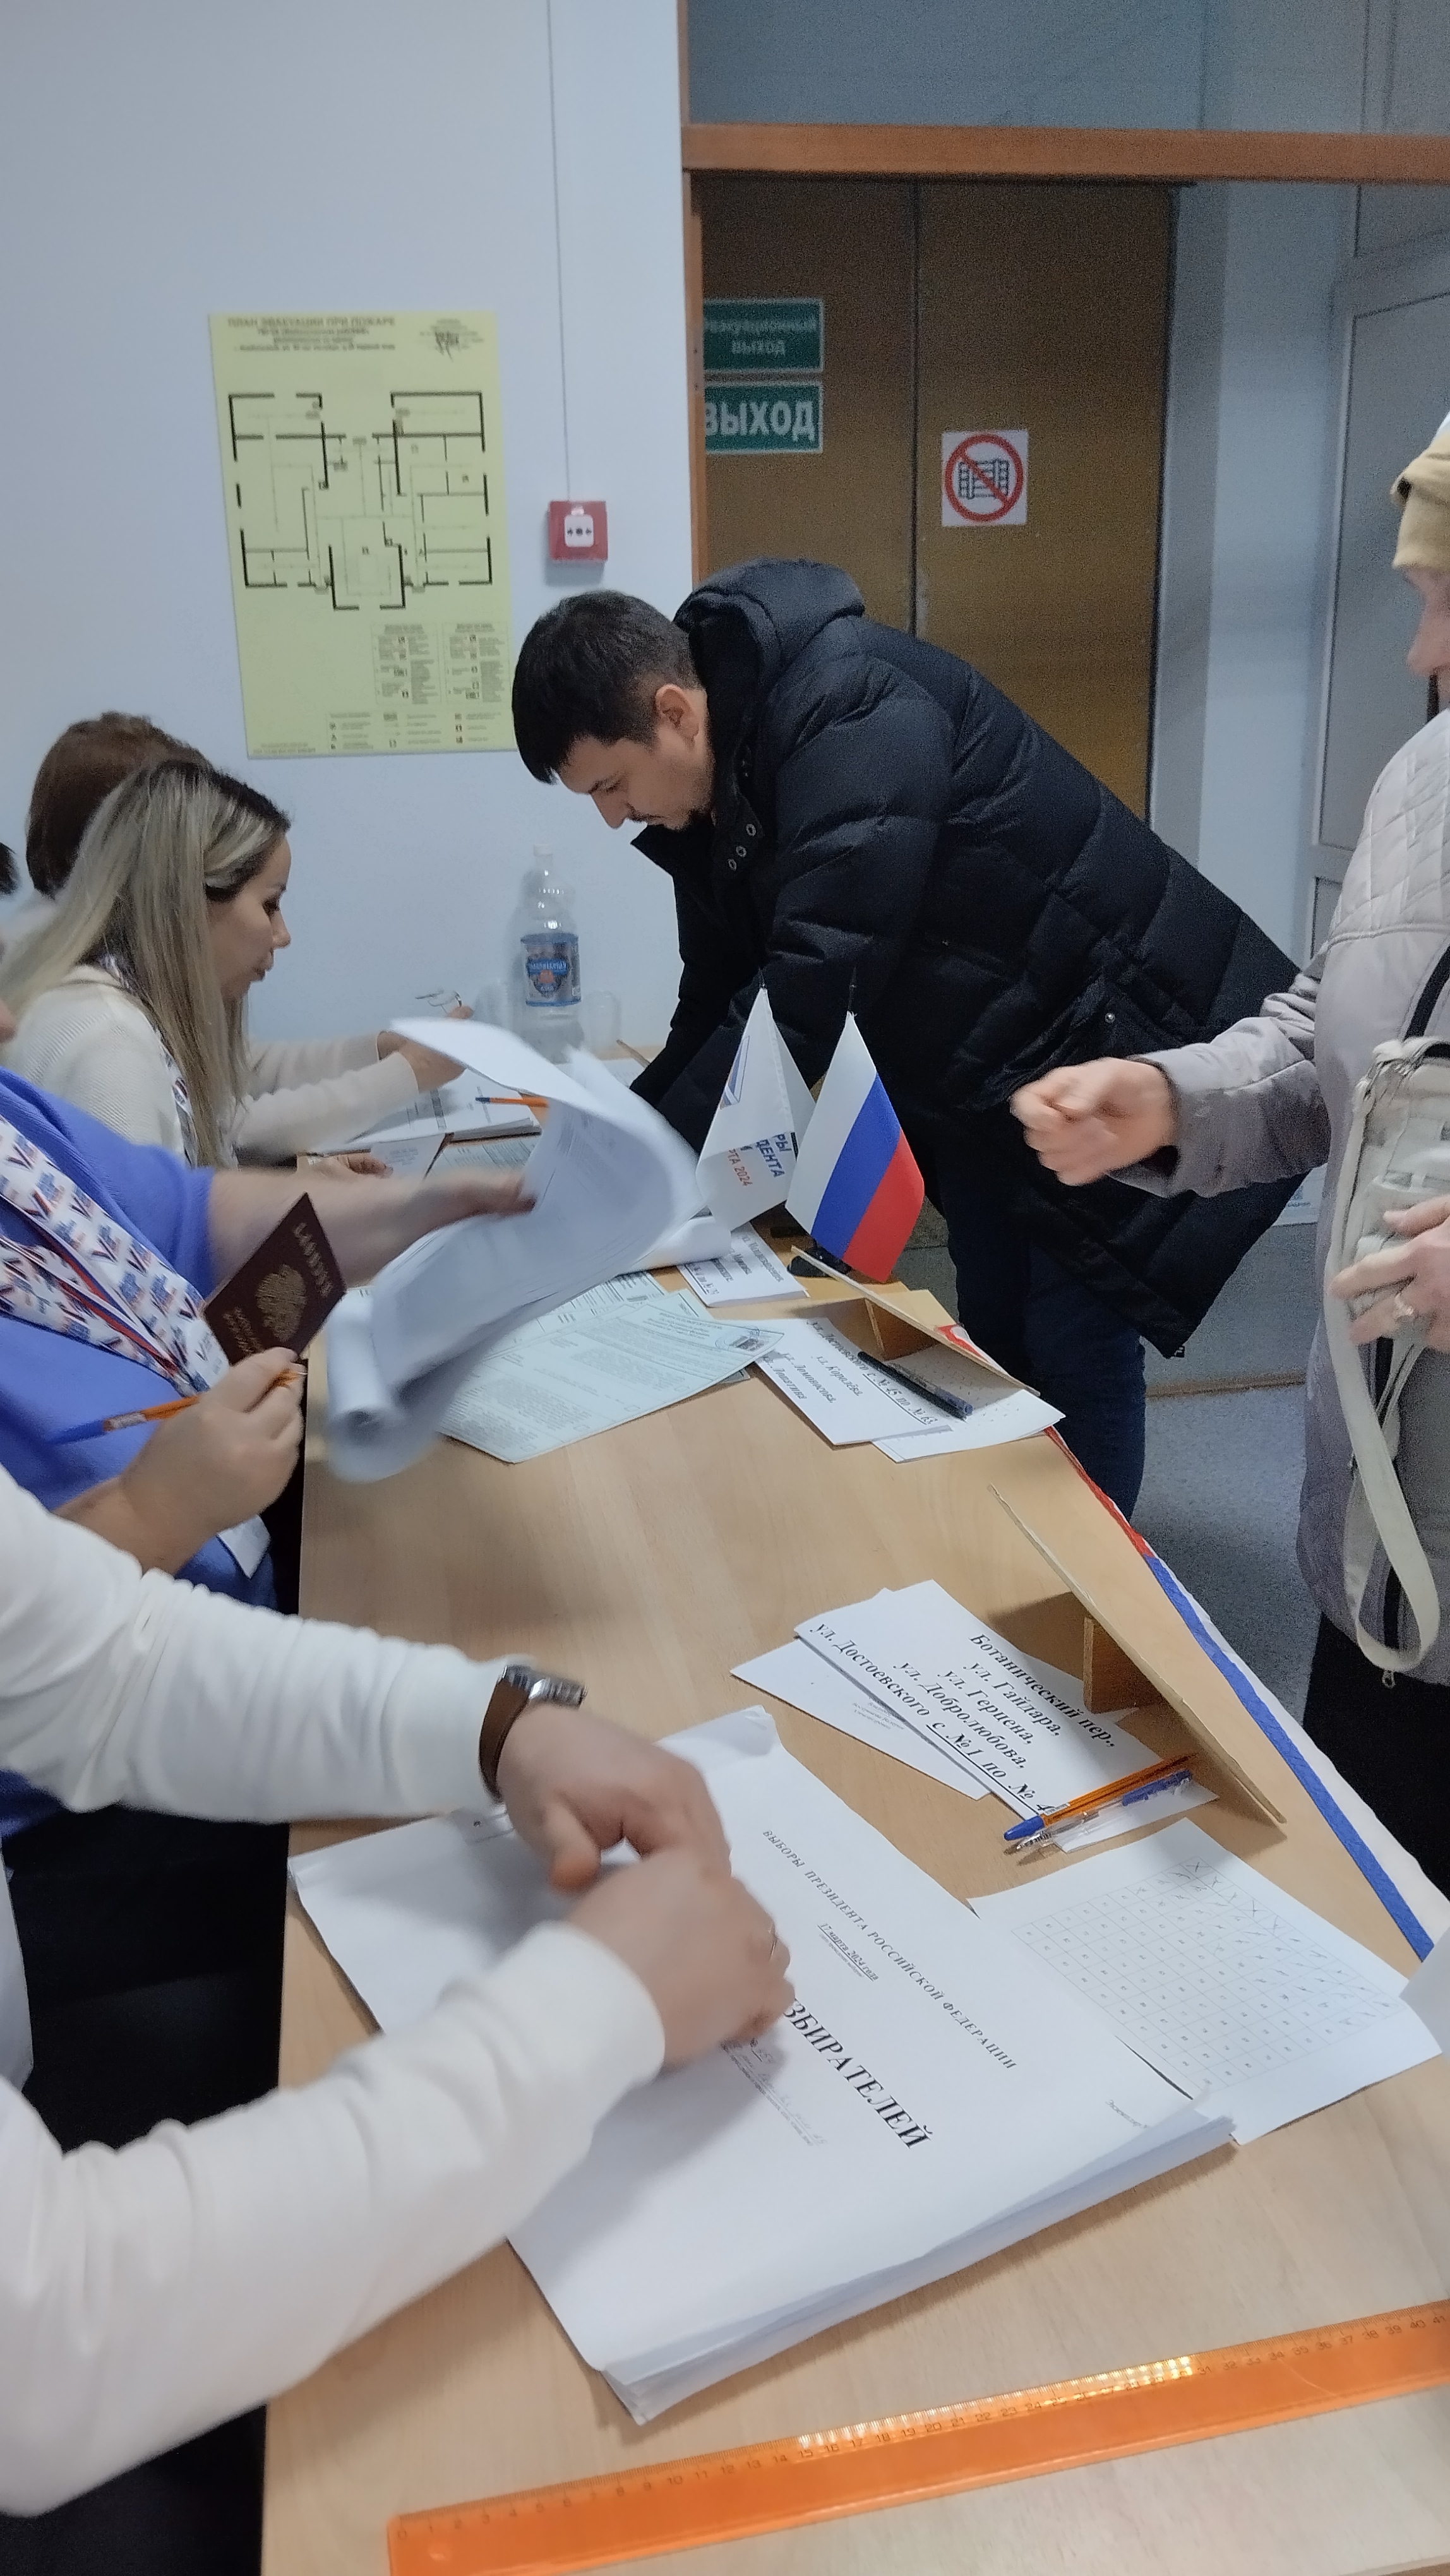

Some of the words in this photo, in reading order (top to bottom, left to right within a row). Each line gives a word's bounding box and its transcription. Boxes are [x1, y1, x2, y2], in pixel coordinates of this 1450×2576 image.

[705, 400, 815, 441] ВЫХОД
[734, 1166, 753, 1186] 2024
[810, 1623, 836, 1642] ул.
[832, 1640, 930, 1716] Достоевского
[981, 1762, 1007, 1778] по
[892, 1662, 921, 1681] ул.
[917, 1682, 1029, 1769] Добролюбова,
[937, 1670, 968, 1690] ул.
[966, 1690, 1036, 1745] Герцена,
[962, 1662, 993, 1682] ул.
[992, 1680, 1063, 1736] Гайдара,
[969, 1634, 1085, 1719] Ботанический
[1077, 1718, 1115, 1748] пер.,
[762, 1829, 806, 1868] ВЫБОРЫ
[804, 1869, 869, 1931] ПРЕЗИДЕНТА
[866, 1931, 945, 2000] РОССИЙСКОЙ
[943, 2001, 1017, 2069] ФЕДЕРАЦИИ
[783, 1998, 933, 2149] ЗБИРАТЕЛЕЙ
[397, 2529, 407, 2539] 0
[537, 2503, 544, 2513] 5
[563, 2498, 571, 2507] 6
[616, 2486, 625, 2496] 8
[644, 2482, 652, 2491] 9
[667, 2475, 683, 2485] 10
[695, 2470, 709, 2480] 11
[721, 2464, 735, 2474] 12
[746, 2460, 761, 2469] 13
[773, 2454, 788, 2464] 14
[798, 2449, 813, 2459] 15
[824, 2443, 839, 2453] 16
[850, 2438, 863, 2448] 17
[875, 2433, 891, 2443] 18
[901, 2428, 916, 2437] 19
[925, 2422, 942, 2433] 20
[950, 2417, 965, 2427] 21
[975, 2412, 992, 2422] 22
[1000, 2407, 1017, 2417] 23
[1024, 2401, 1042, 2411] 24
[1197, 2366, 1211, 2375] 31
[1268, 2351, 1285, 2361] 34
[1292, 2346, 1309, 2356] 35
[1315, 2340, 1333, 2351] 36
[1339, 2335, 1353, 2346] 37
[1362, 2330, 1379, 2340] 38
[1384, 2325, 1402, 2335] 39
[1410, 2319, 1426, 2329] 40
